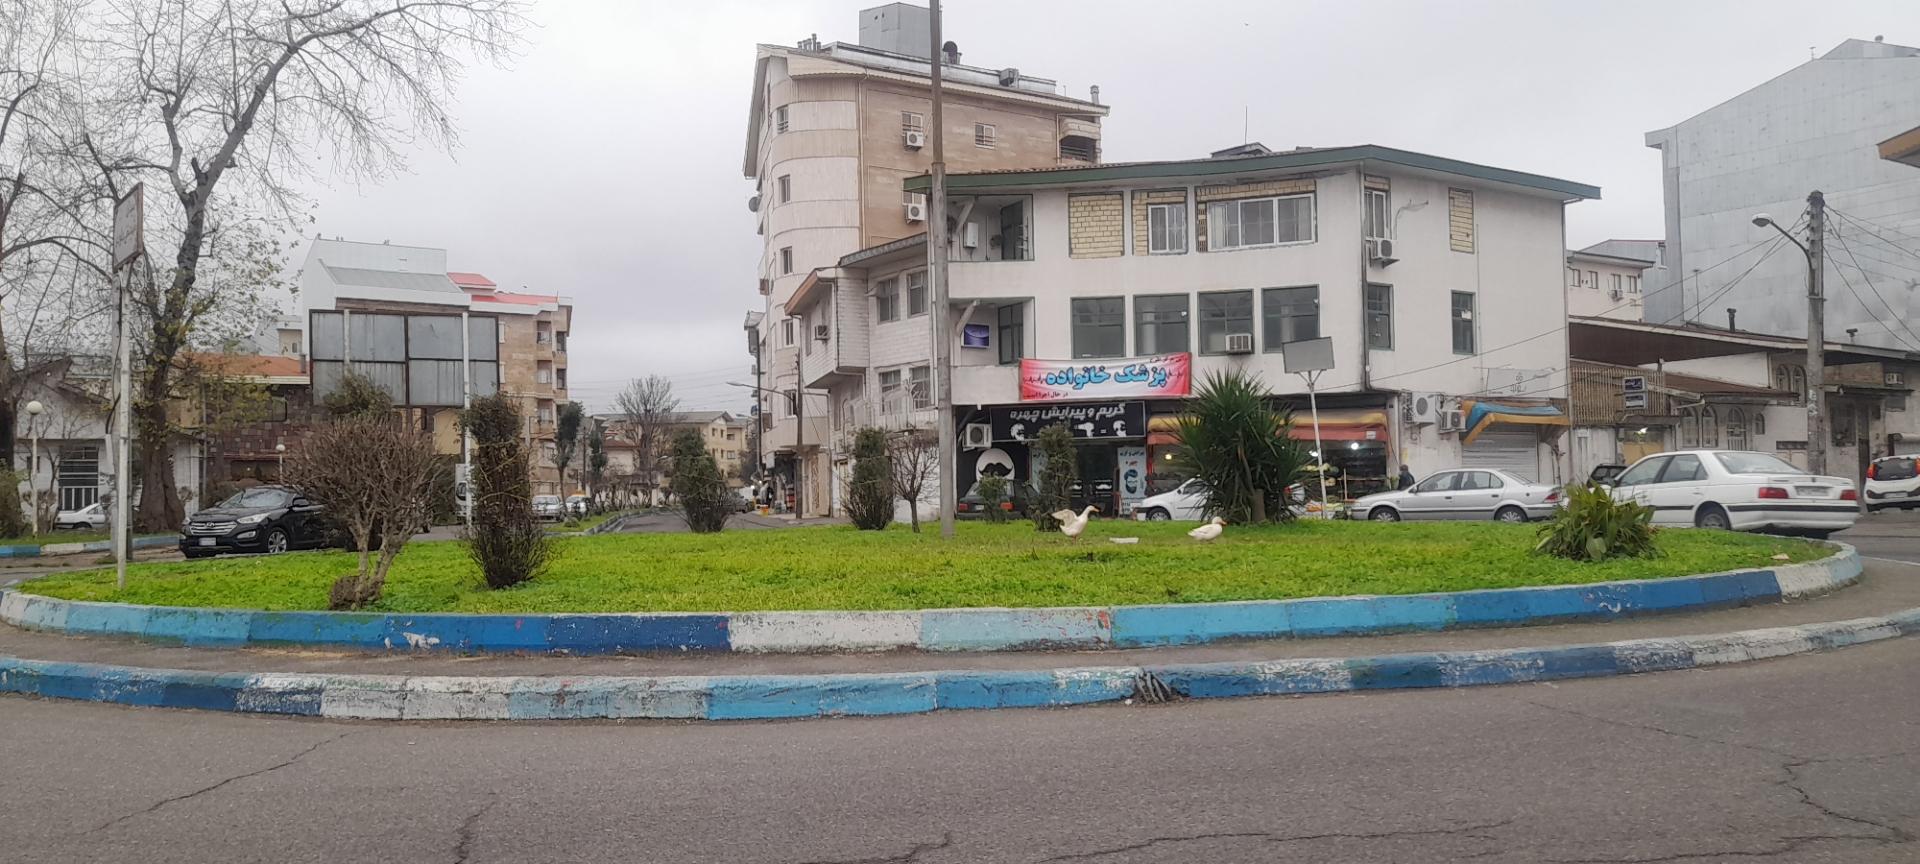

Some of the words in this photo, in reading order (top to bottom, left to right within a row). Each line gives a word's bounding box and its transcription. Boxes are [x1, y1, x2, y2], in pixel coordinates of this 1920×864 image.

[1046, 366, 1111, 390] خانواده
[1114, 364, 1167, 388] پزشک
[1050, 391, 1061, 399] حال
[1009, 410, 1040, 423] چهره
[1041, 406, 1086, 421] پیرایش
[1087, 408, 1095, 418] و
[1096, 403, 1126, 420] گریم
